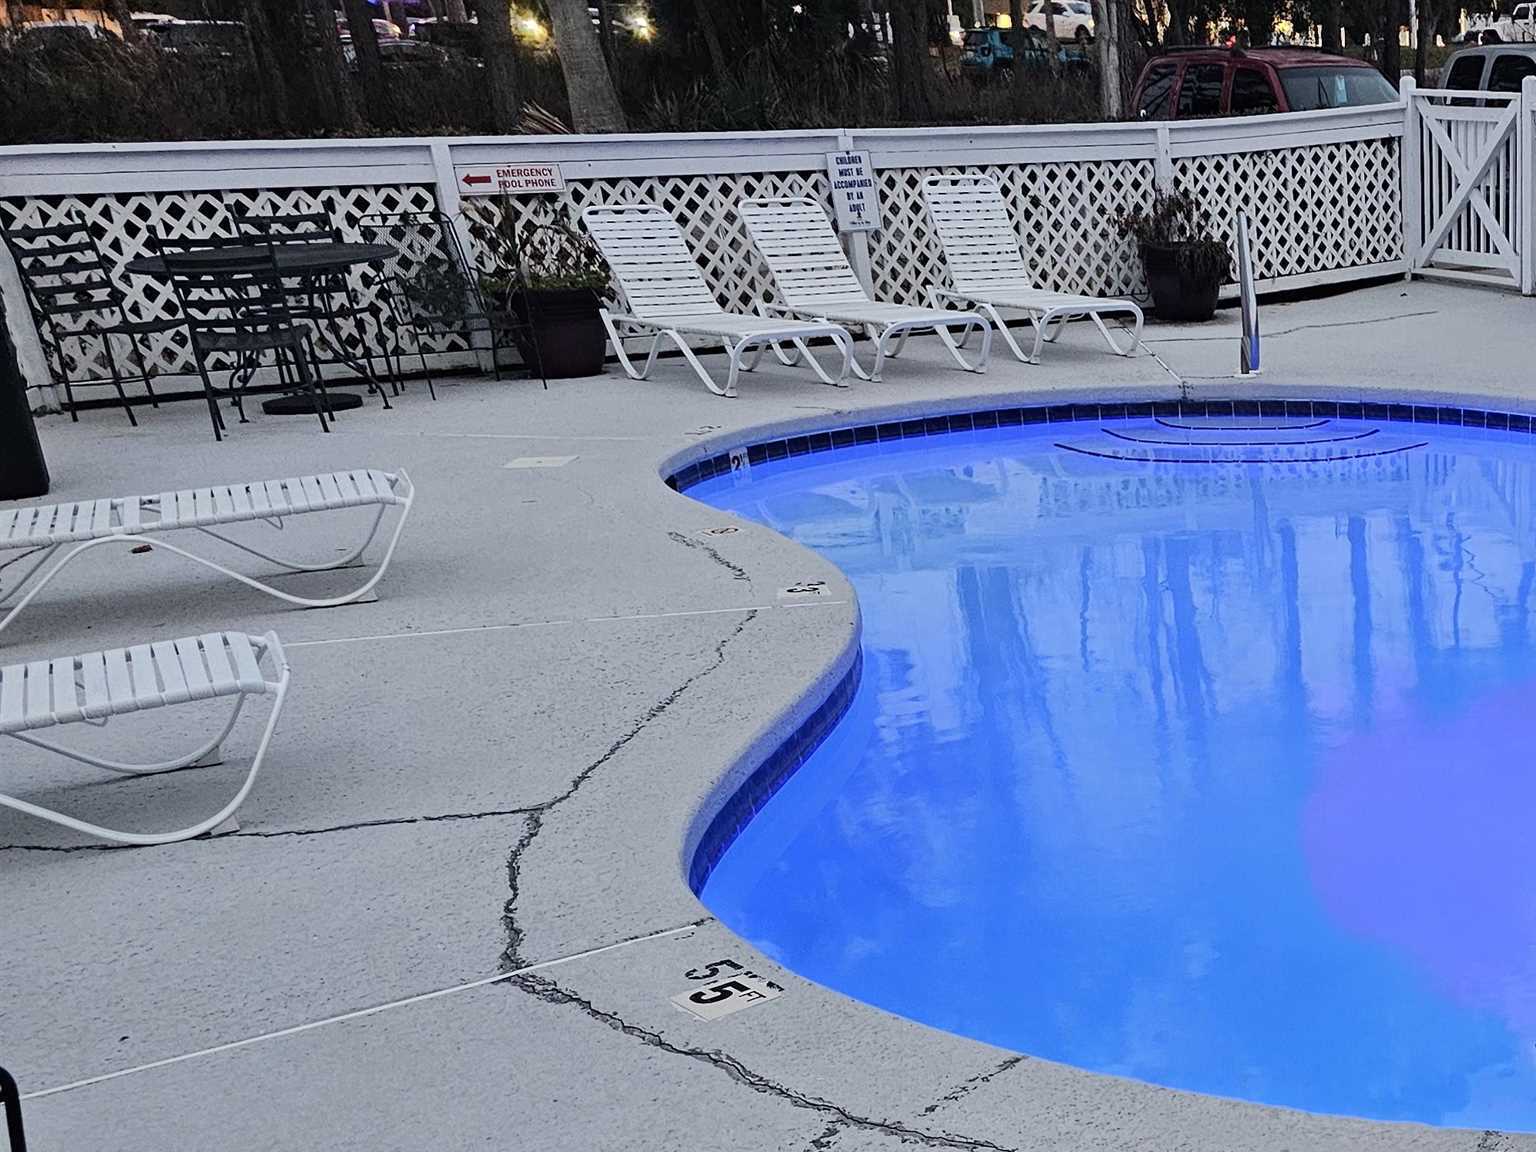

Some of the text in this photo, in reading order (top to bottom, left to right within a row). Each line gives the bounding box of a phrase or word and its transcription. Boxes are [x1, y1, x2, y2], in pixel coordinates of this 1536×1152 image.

[496, 168, 553, 178] EMERGENCY
[838, 168, 854, 177] MUST
[498, 178, 557, 189] POOL PHONE
